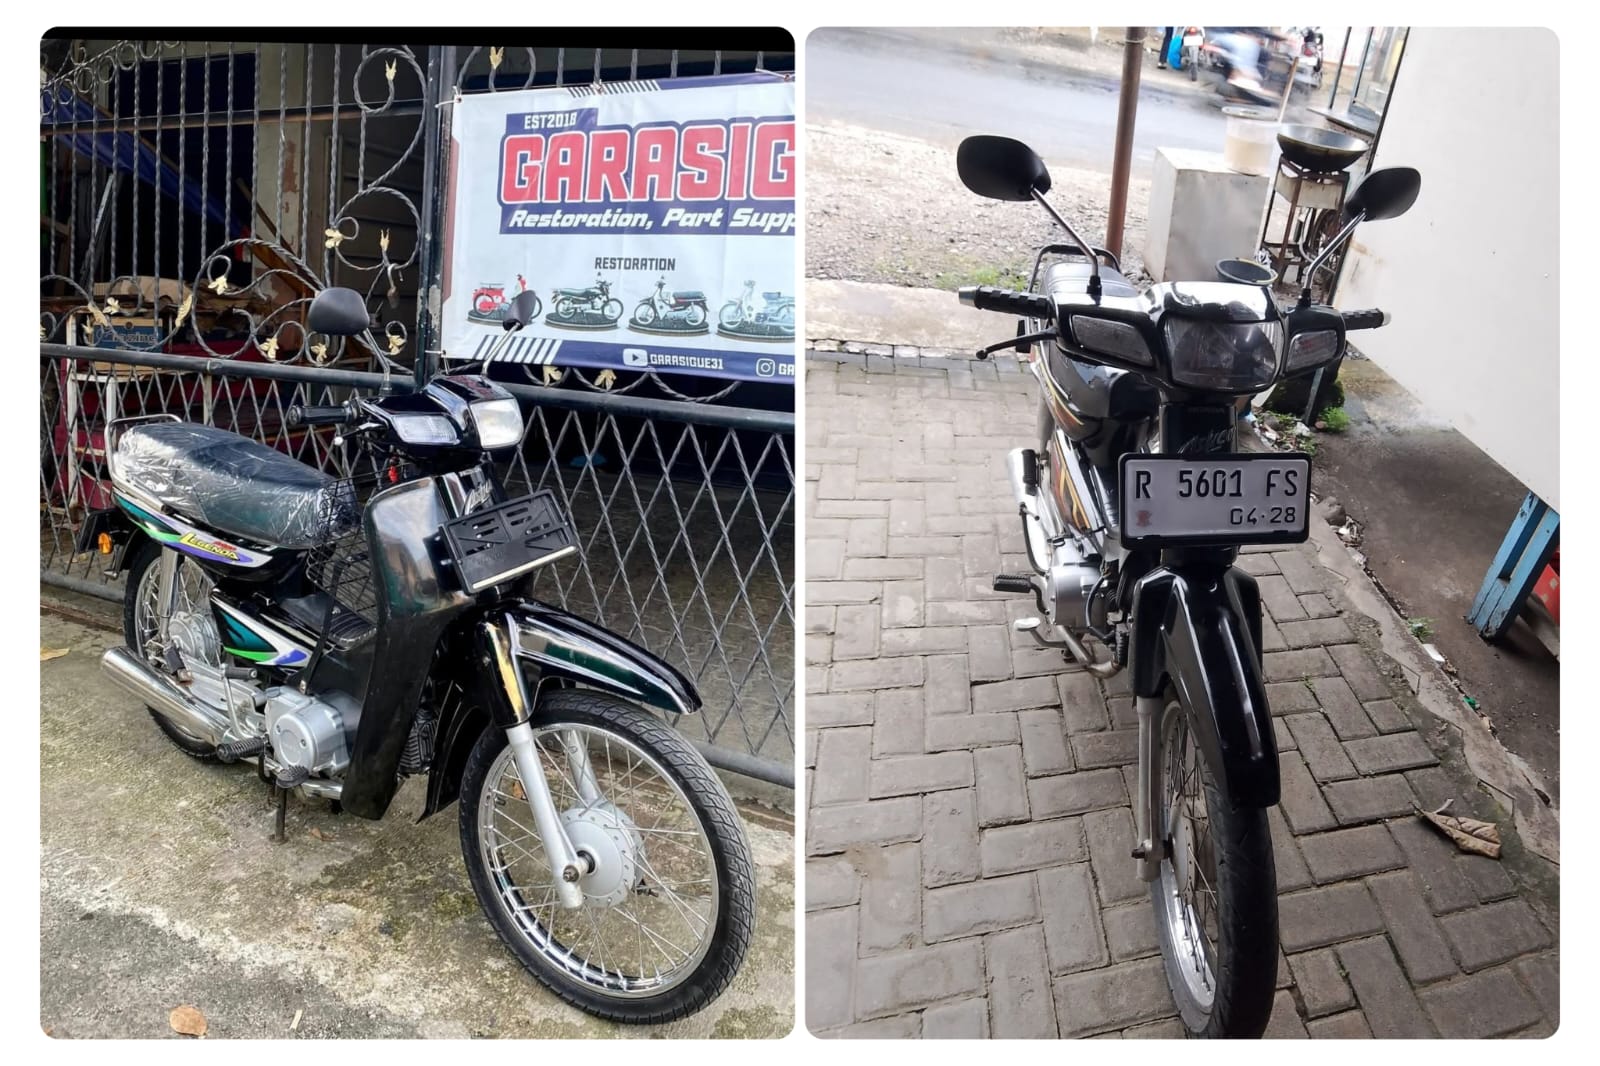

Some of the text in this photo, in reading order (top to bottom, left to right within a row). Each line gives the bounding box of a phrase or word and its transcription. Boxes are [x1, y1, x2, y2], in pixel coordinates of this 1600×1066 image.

[523, 112, 577, 130] EST2018
[501, 123, 795, 204] GARASIG
[509, 208, 653, 231] Restoration,
[662, 207, 724, 228] Part
[595, 257, 676, 271] RESTORATION
[650, 353, 724, 370] GARASIGUE31
[1136, 469, 1298, 499] R 5601 FS
